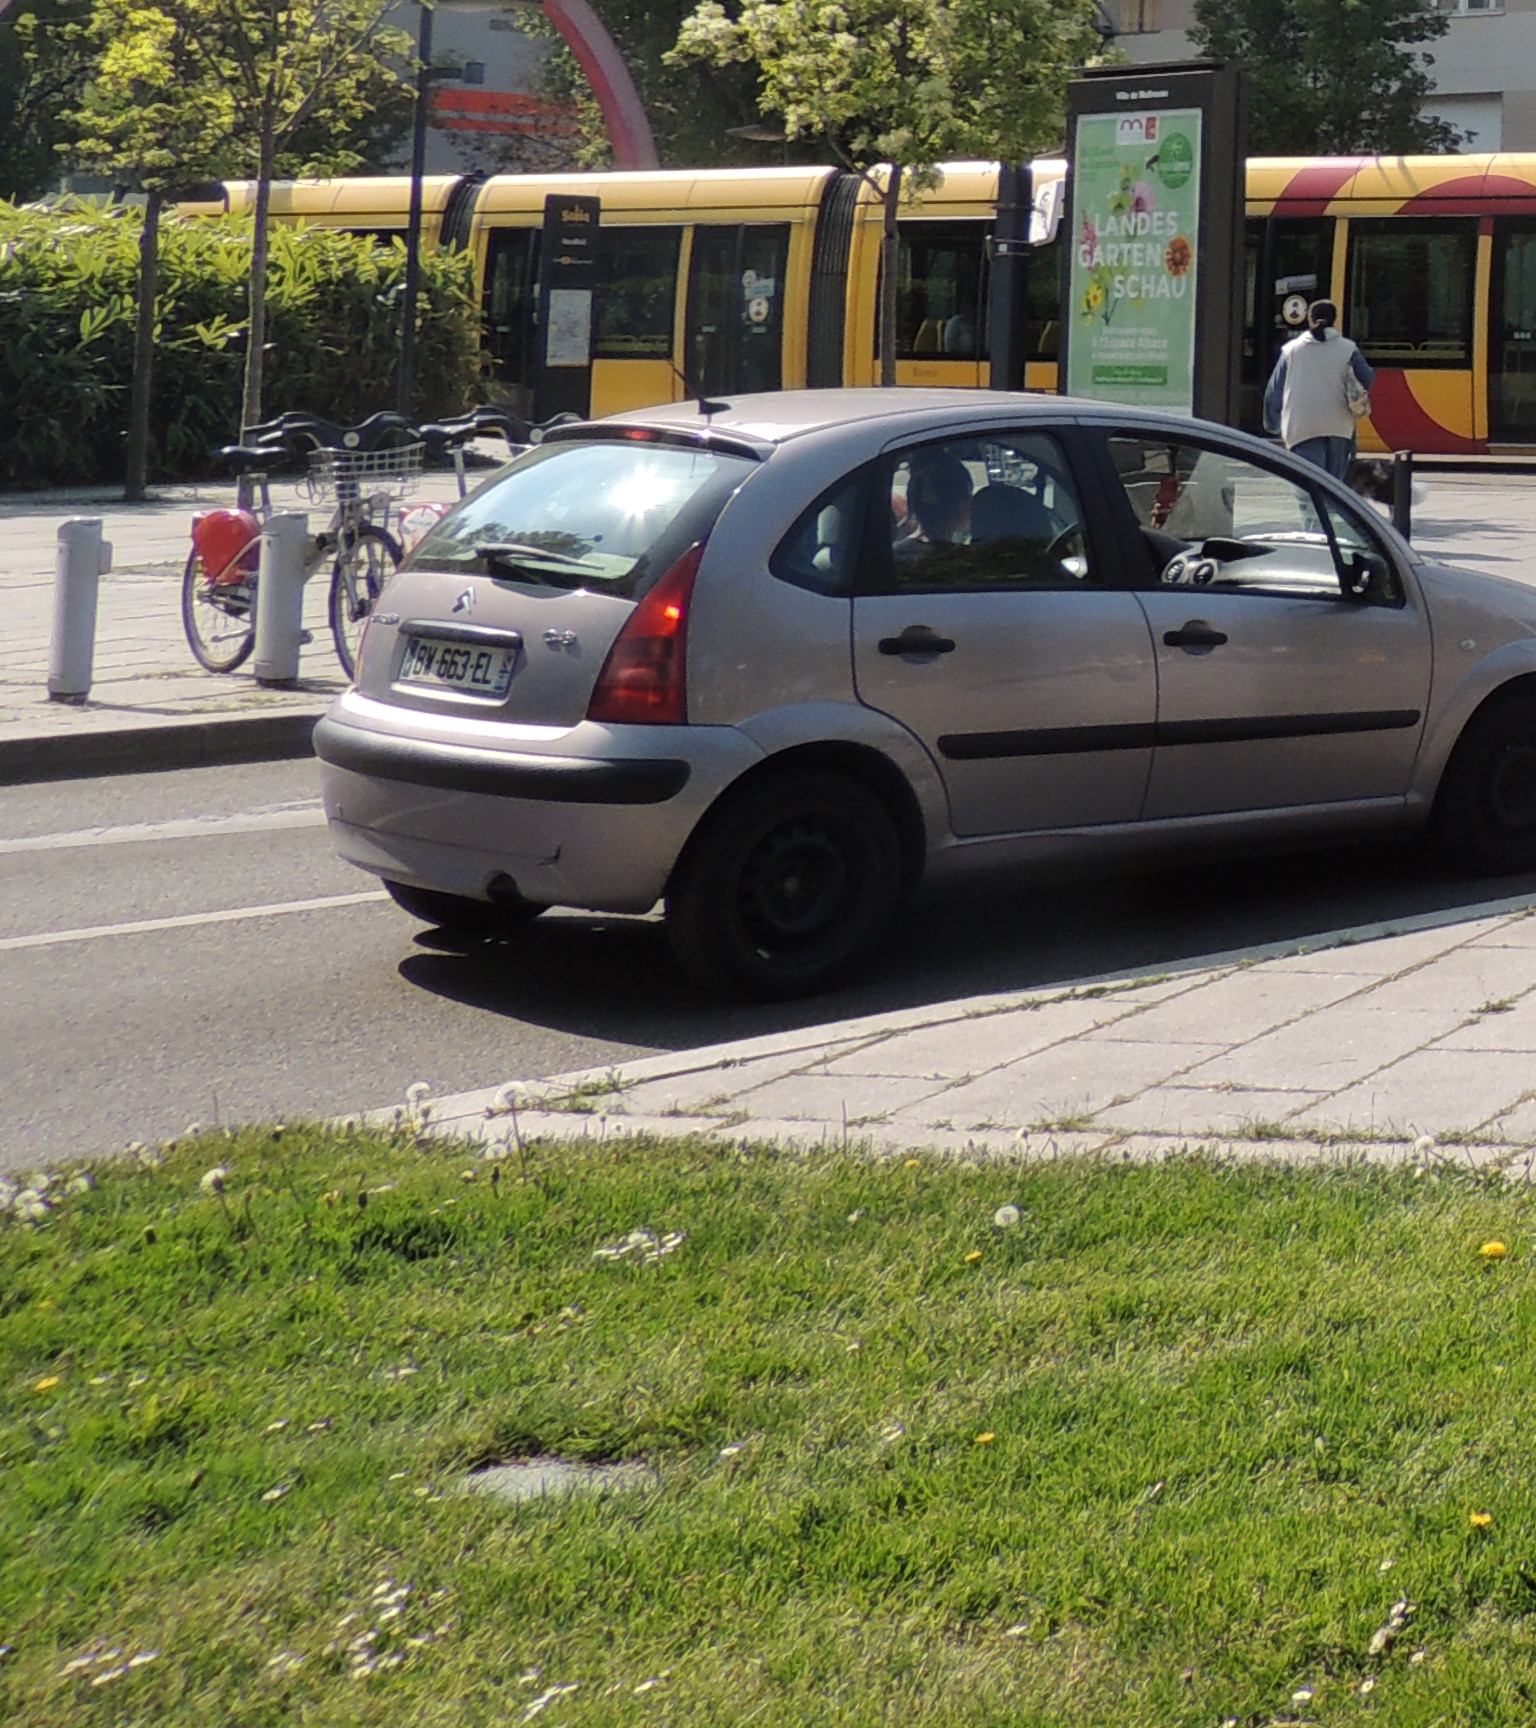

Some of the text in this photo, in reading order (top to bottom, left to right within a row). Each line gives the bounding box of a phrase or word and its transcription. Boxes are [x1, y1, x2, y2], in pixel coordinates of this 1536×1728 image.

[1095, 211, 1178, 237] LANDES
[1078, 243, 1161, 268] GARTEN
[1113, 274, 1187, 299] SCHAU
[412, 645, 492, 685] BW-663-EL
